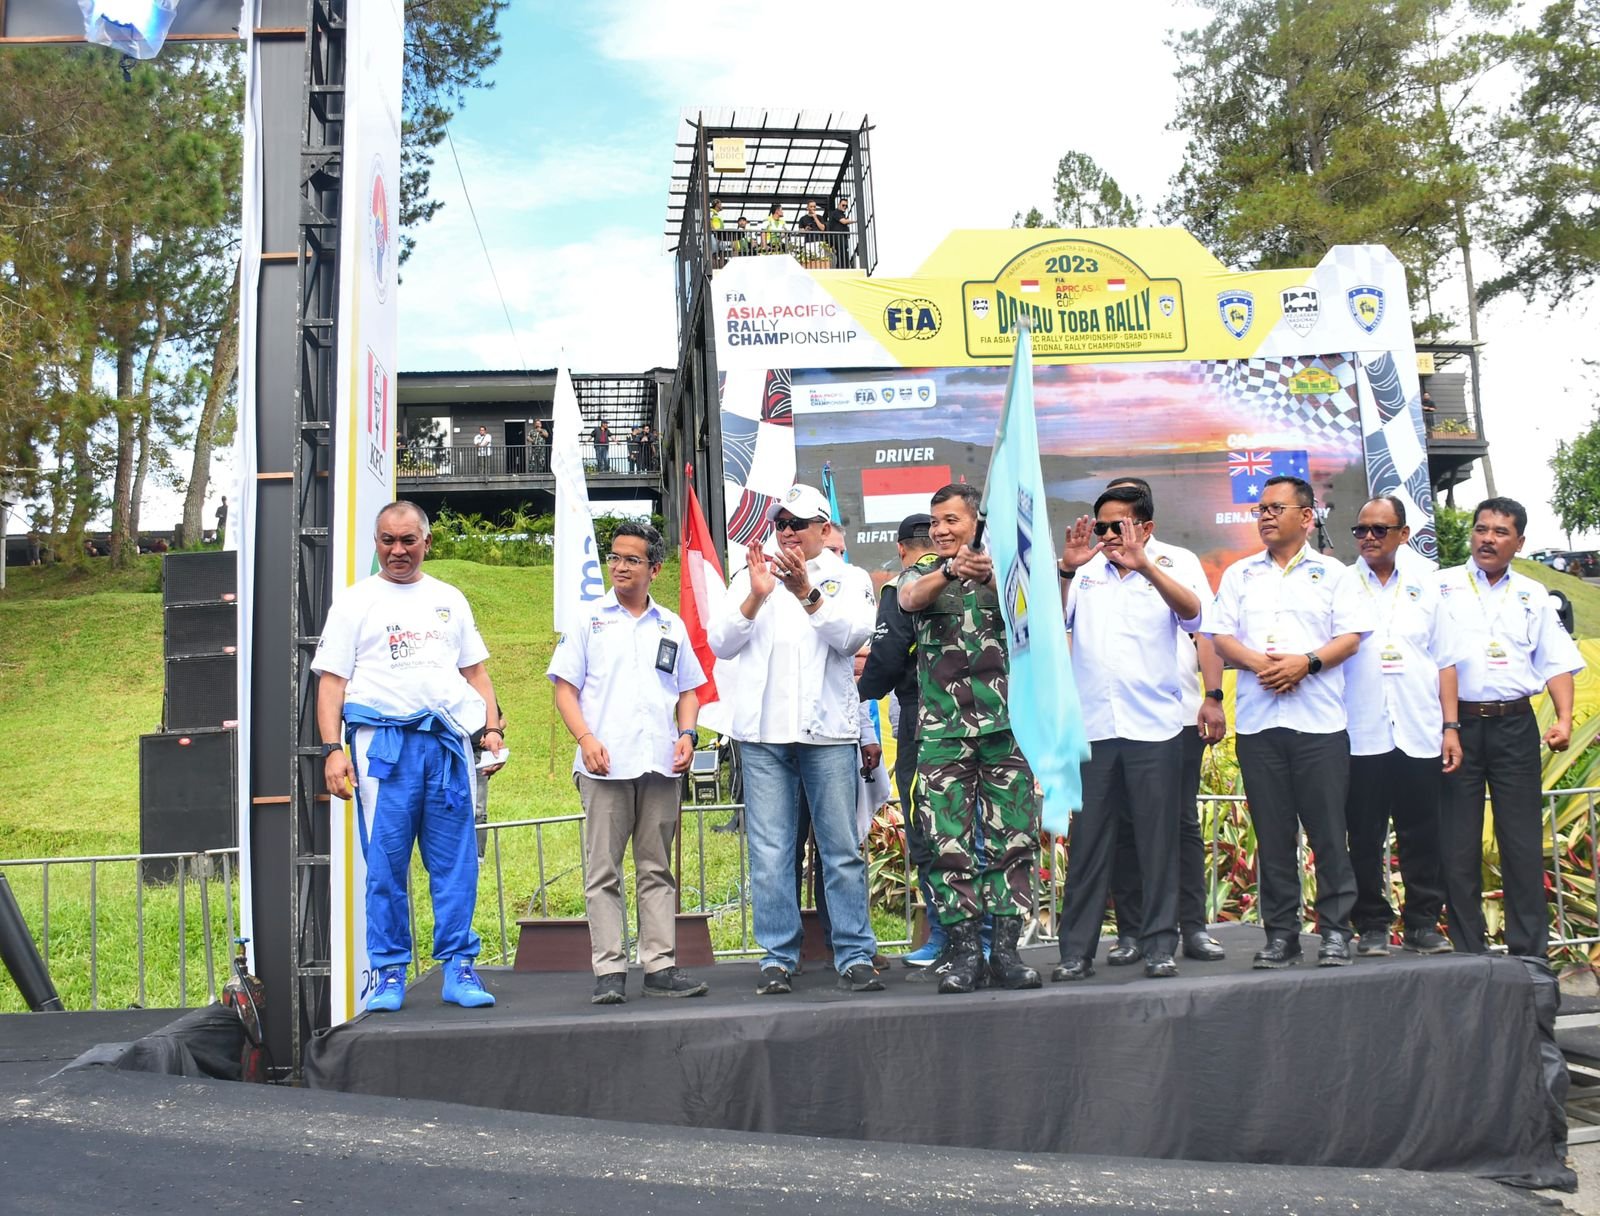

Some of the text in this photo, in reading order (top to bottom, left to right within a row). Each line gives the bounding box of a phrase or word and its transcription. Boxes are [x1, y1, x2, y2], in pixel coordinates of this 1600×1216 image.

[1045, 254, 1099, 273] 2023
[727, 304, 836, 319] ASIA-PACIFIC
[996, 287, 1151, 334] DANAU TOBA RALLY
[727, 319, 779, 333] RALLY
[728, 330, 857, 346] CHAMPIONSHIP
[1065, 333, 1118, 342] CHAMPIONSHIP
[1088, 341, 1142, 349] CHAMPIONSHIP
[875, 447, 934, 463] DRIVER
[856, 530, 898, 543] RIFAT
[391, 649, 416, 660] CUP
